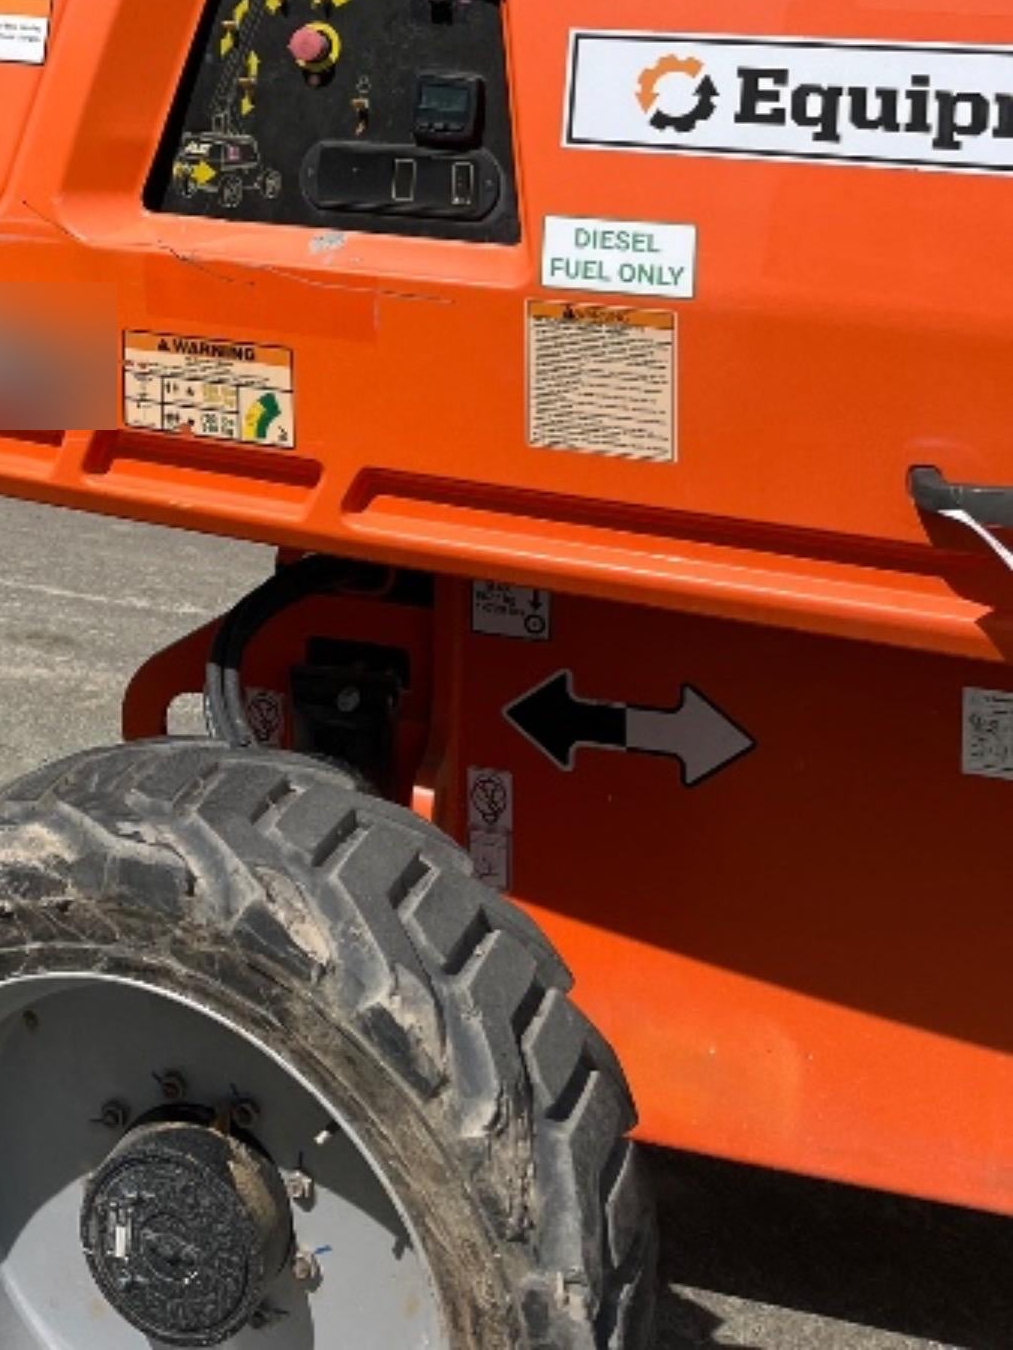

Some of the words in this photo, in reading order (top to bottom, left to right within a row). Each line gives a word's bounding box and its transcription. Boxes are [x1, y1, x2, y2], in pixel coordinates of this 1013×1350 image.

[734, 67, 1013, 150] Equip
[574, 227, 661, 253] DIESEL
[550, 257, 611, 282] FUEL
[619, 263, 685, 286] ONLY
[172, 337, 255, 361] WARNING
